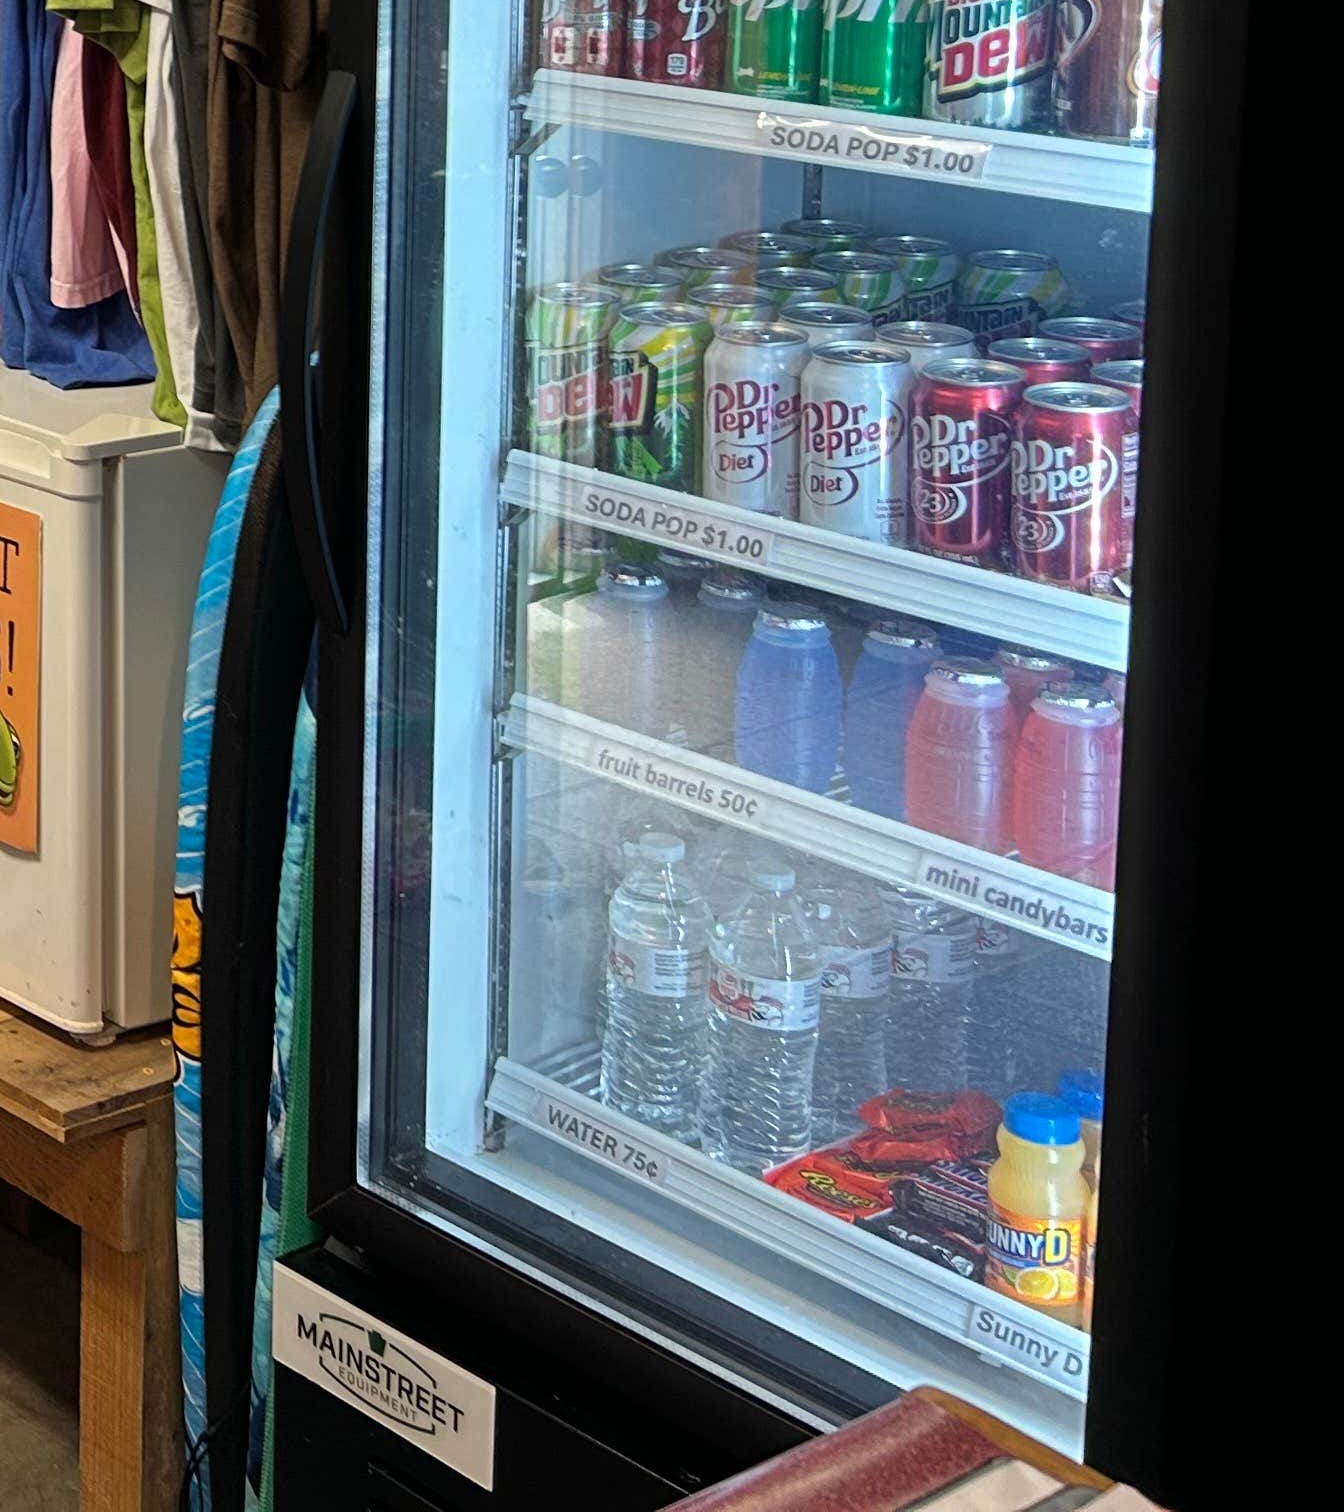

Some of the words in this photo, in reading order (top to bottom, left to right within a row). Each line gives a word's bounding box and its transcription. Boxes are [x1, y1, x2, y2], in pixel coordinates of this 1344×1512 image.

[770, 126, 840, 154] SODA
[847, 135, 900, 160] POP
[904, 142, 975, 175] $1.00
[714, 384, 801, 434] Pepper
[735, 381, 780, 406] Dr
[826, 400, 868, 426] Dr
[804, 402, 891, 458] Pepper
[930, 415, 976, 443] Dr
[1027, 440, 1073, 470] Dr
[718, 453, 754, 472] Diet
[808, 476, 843, 494] Diet
[585, 492, 648, 529] SODA
[653, 510, 698, 541] POP
[703, 524, 764, 559] $1.00
[598, 747, 640, 780] fruit
[644, 761, 715, 806] barrels
[718, 786, 759, 818] 50¢
[926, 862, 980, 894] mini
[984, 881, 1109, 947] candybars
[548, 1104, 618, 1156] WATER
[622, 1145, 660, 1182] 75¢
[976, 1310, 1058, 1366] Sunny
[1062, 1351, 1085, 1379] D
[296, 1313, 465, 1433] MAINSTREET
[337, 1365, 419, 1424] EQUIPMENT
